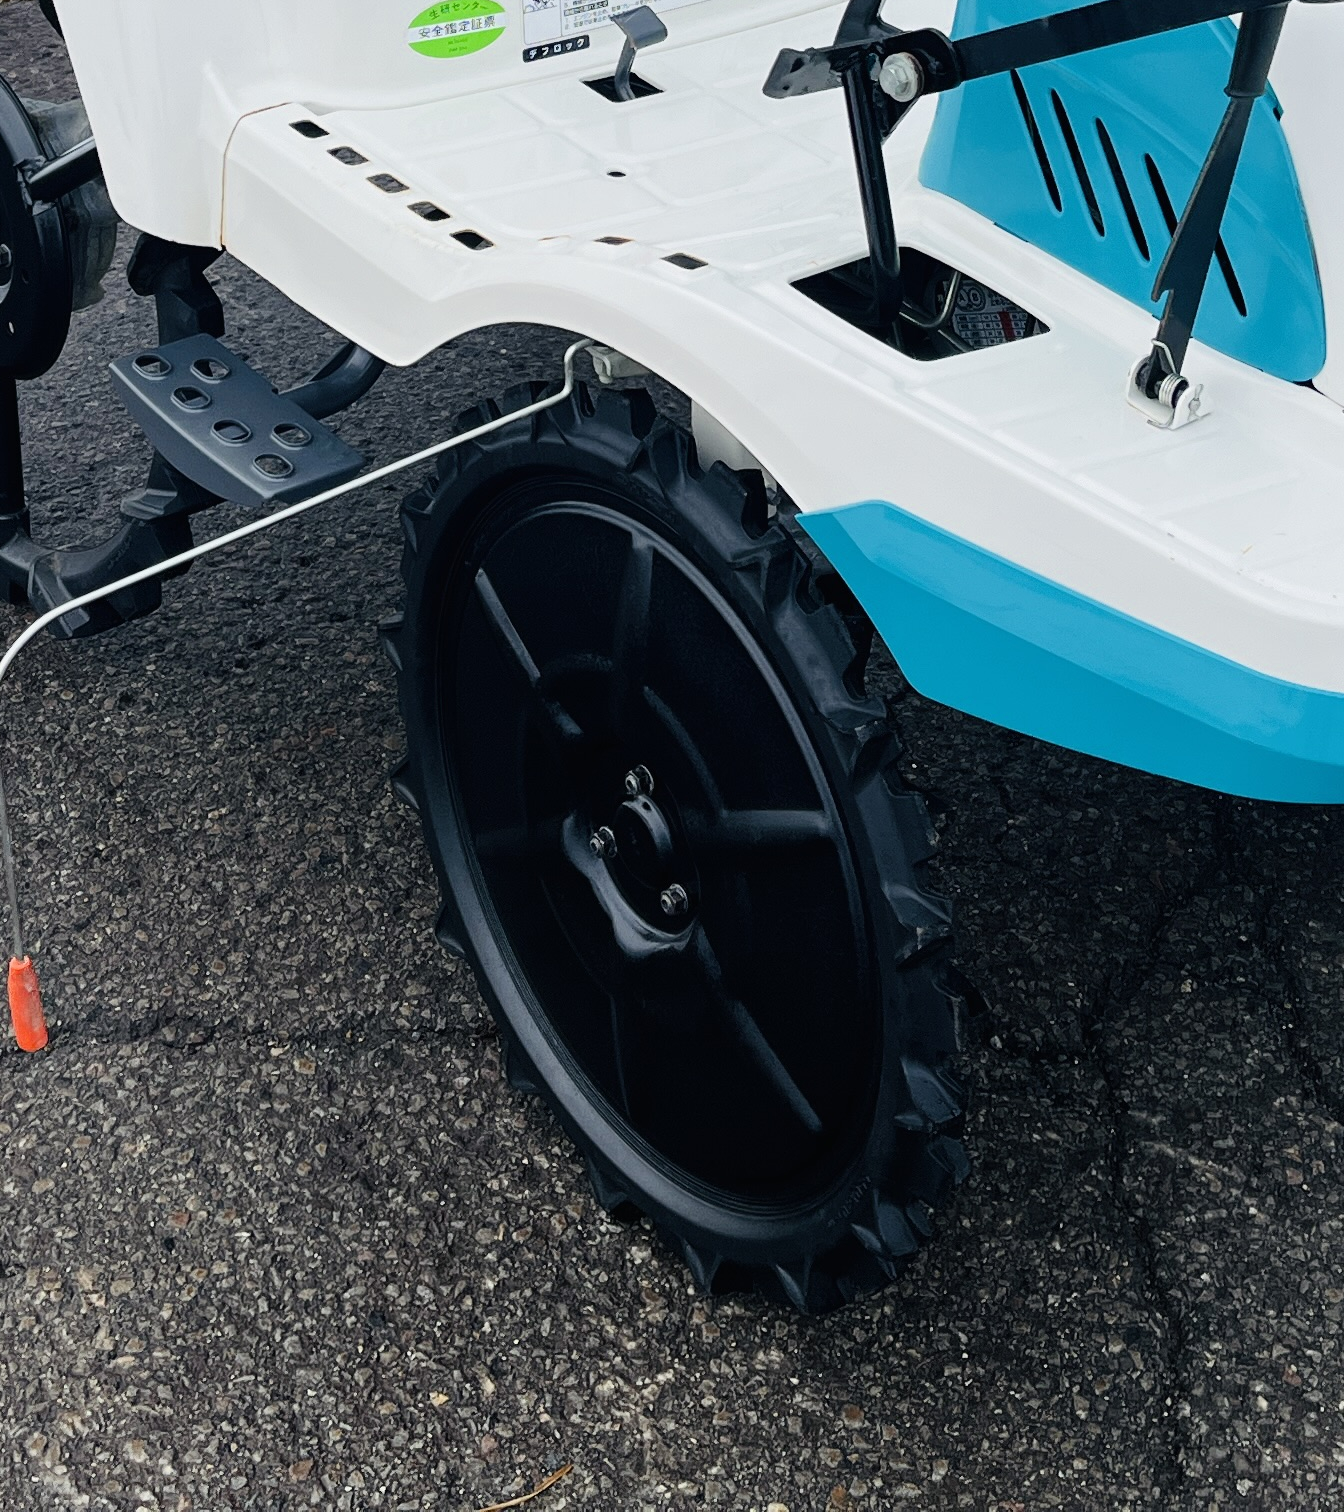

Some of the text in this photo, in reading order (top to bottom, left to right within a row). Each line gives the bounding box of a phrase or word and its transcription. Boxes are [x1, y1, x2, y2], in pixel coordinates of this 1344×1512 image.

[429, 1, 490, 20] 生研センター
